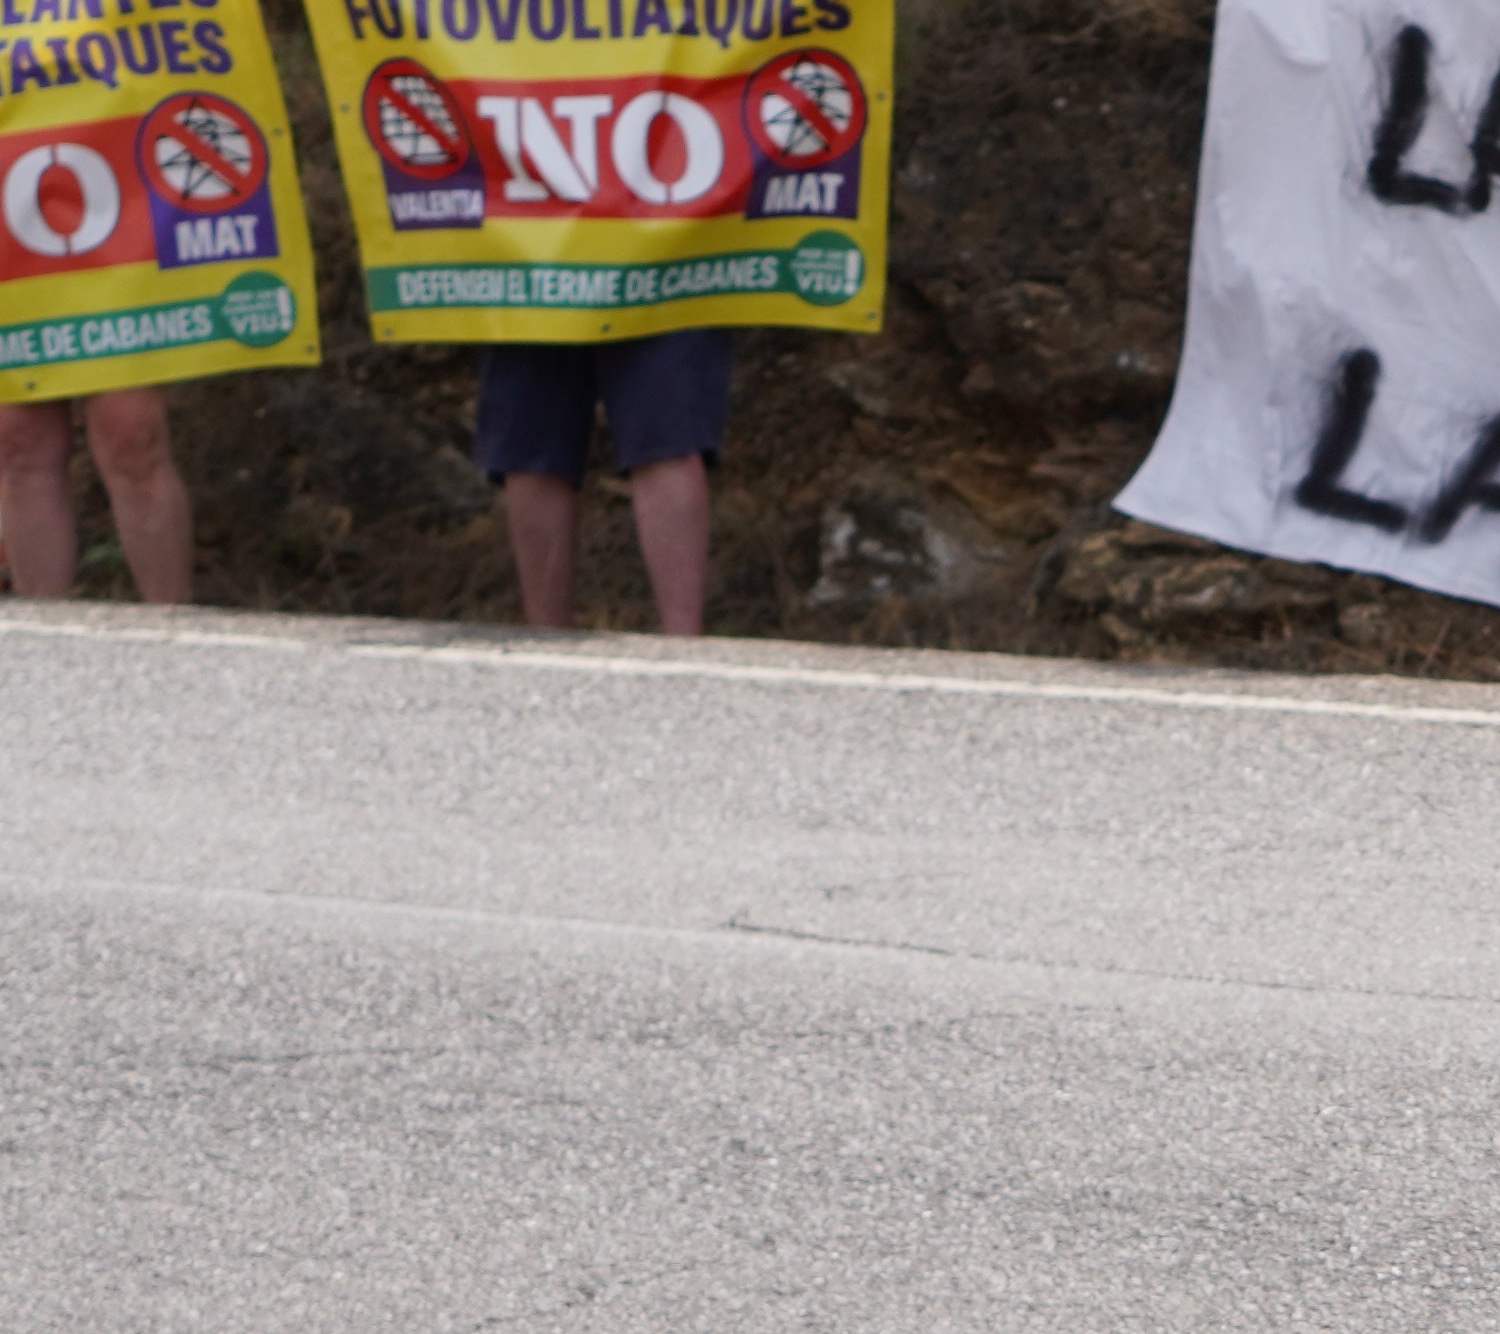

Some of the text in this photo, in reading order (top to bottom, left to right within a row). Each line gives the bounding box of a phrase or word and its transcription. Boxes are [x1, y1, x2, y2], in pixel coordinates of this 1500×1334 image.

[476, 90, 725, 205] NO
[763, 173, 845, 214] MAT
[173, 214, 259, 262] MAT
[529, 269, 621, 306] TERME
[624, 267, 660, 302] DE
[660, 255, 779, 299] CABANES
[41, 323, 79, 358] DE
[80, 304, 213, 354] CABANES
